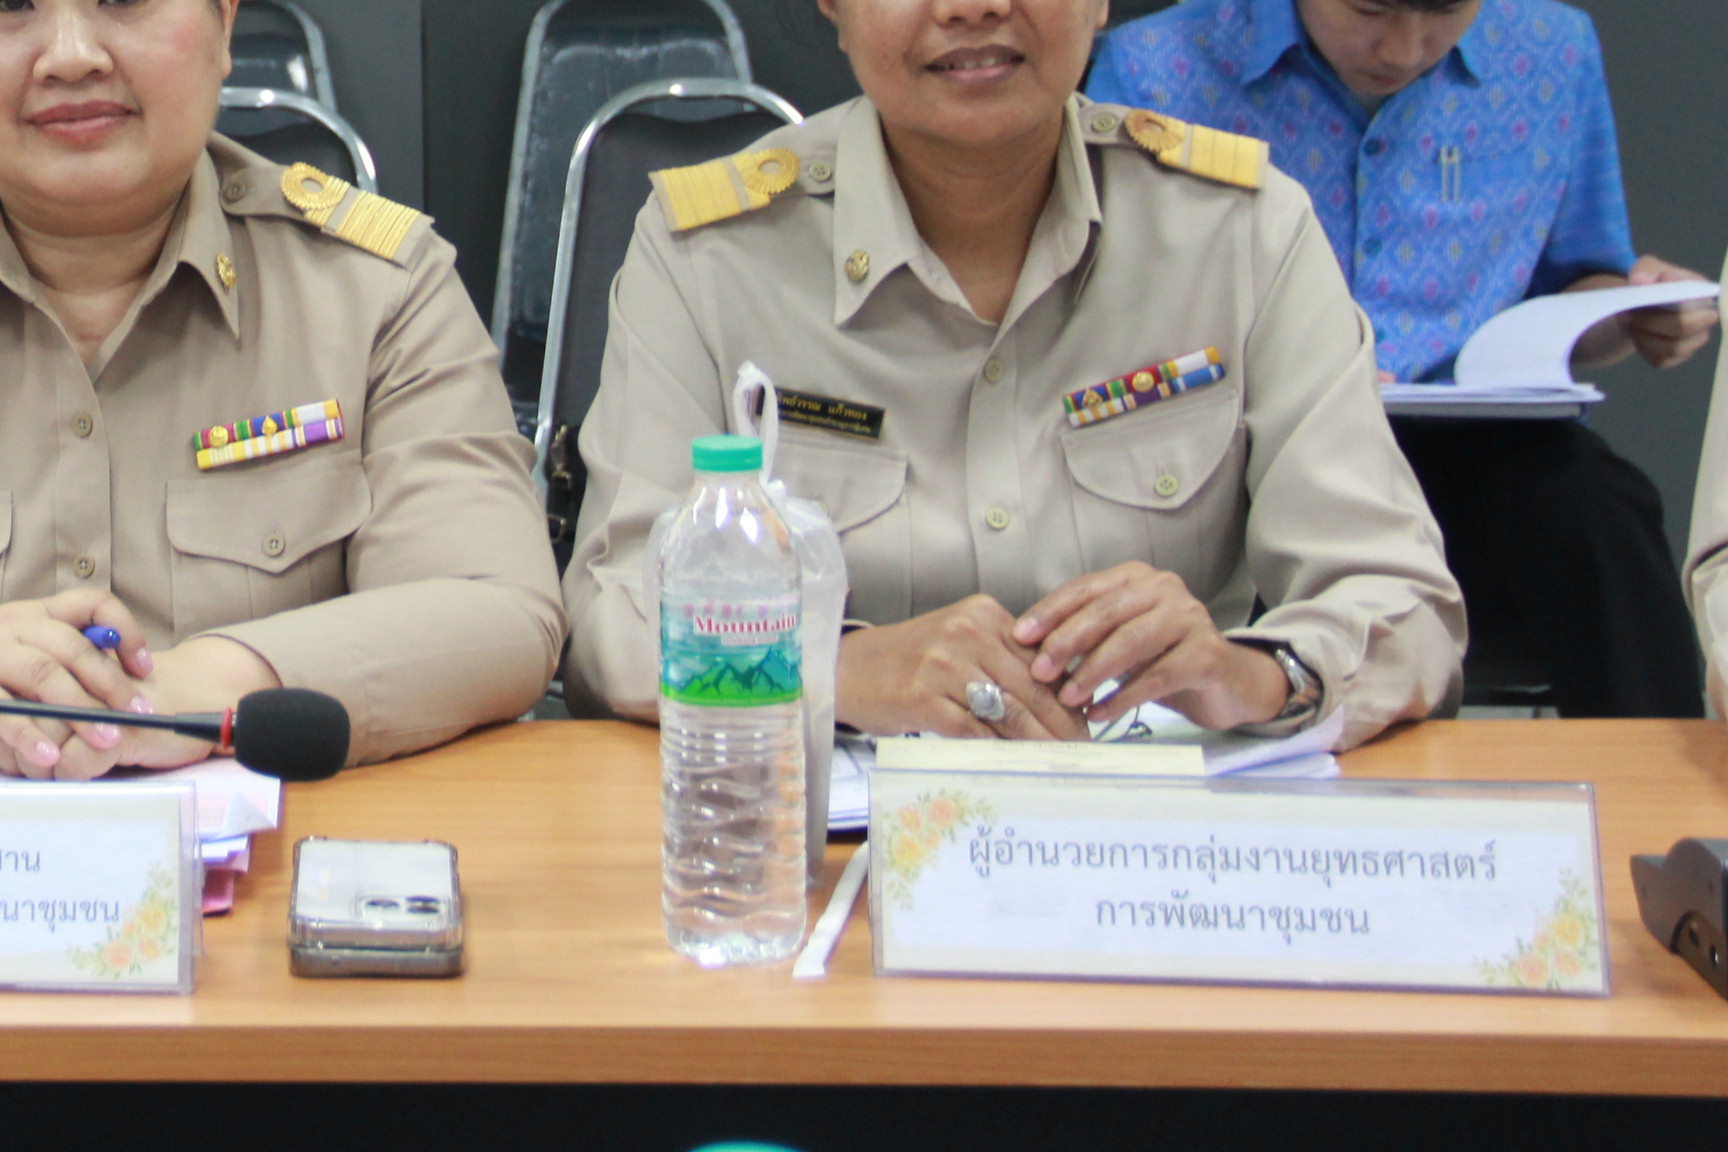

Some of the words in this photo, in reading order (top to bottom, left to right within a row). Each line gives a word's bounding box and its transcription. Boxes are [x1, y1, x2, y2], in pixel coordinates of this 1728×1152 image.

[694, 613, 797, 634] Mountain
[969, 824, 1497, 888] ผู้อำนวยการกลุ่มงานยุทธศาสตร์
[1095, 889, 1371, 946] การพัฒนาชุมชน
